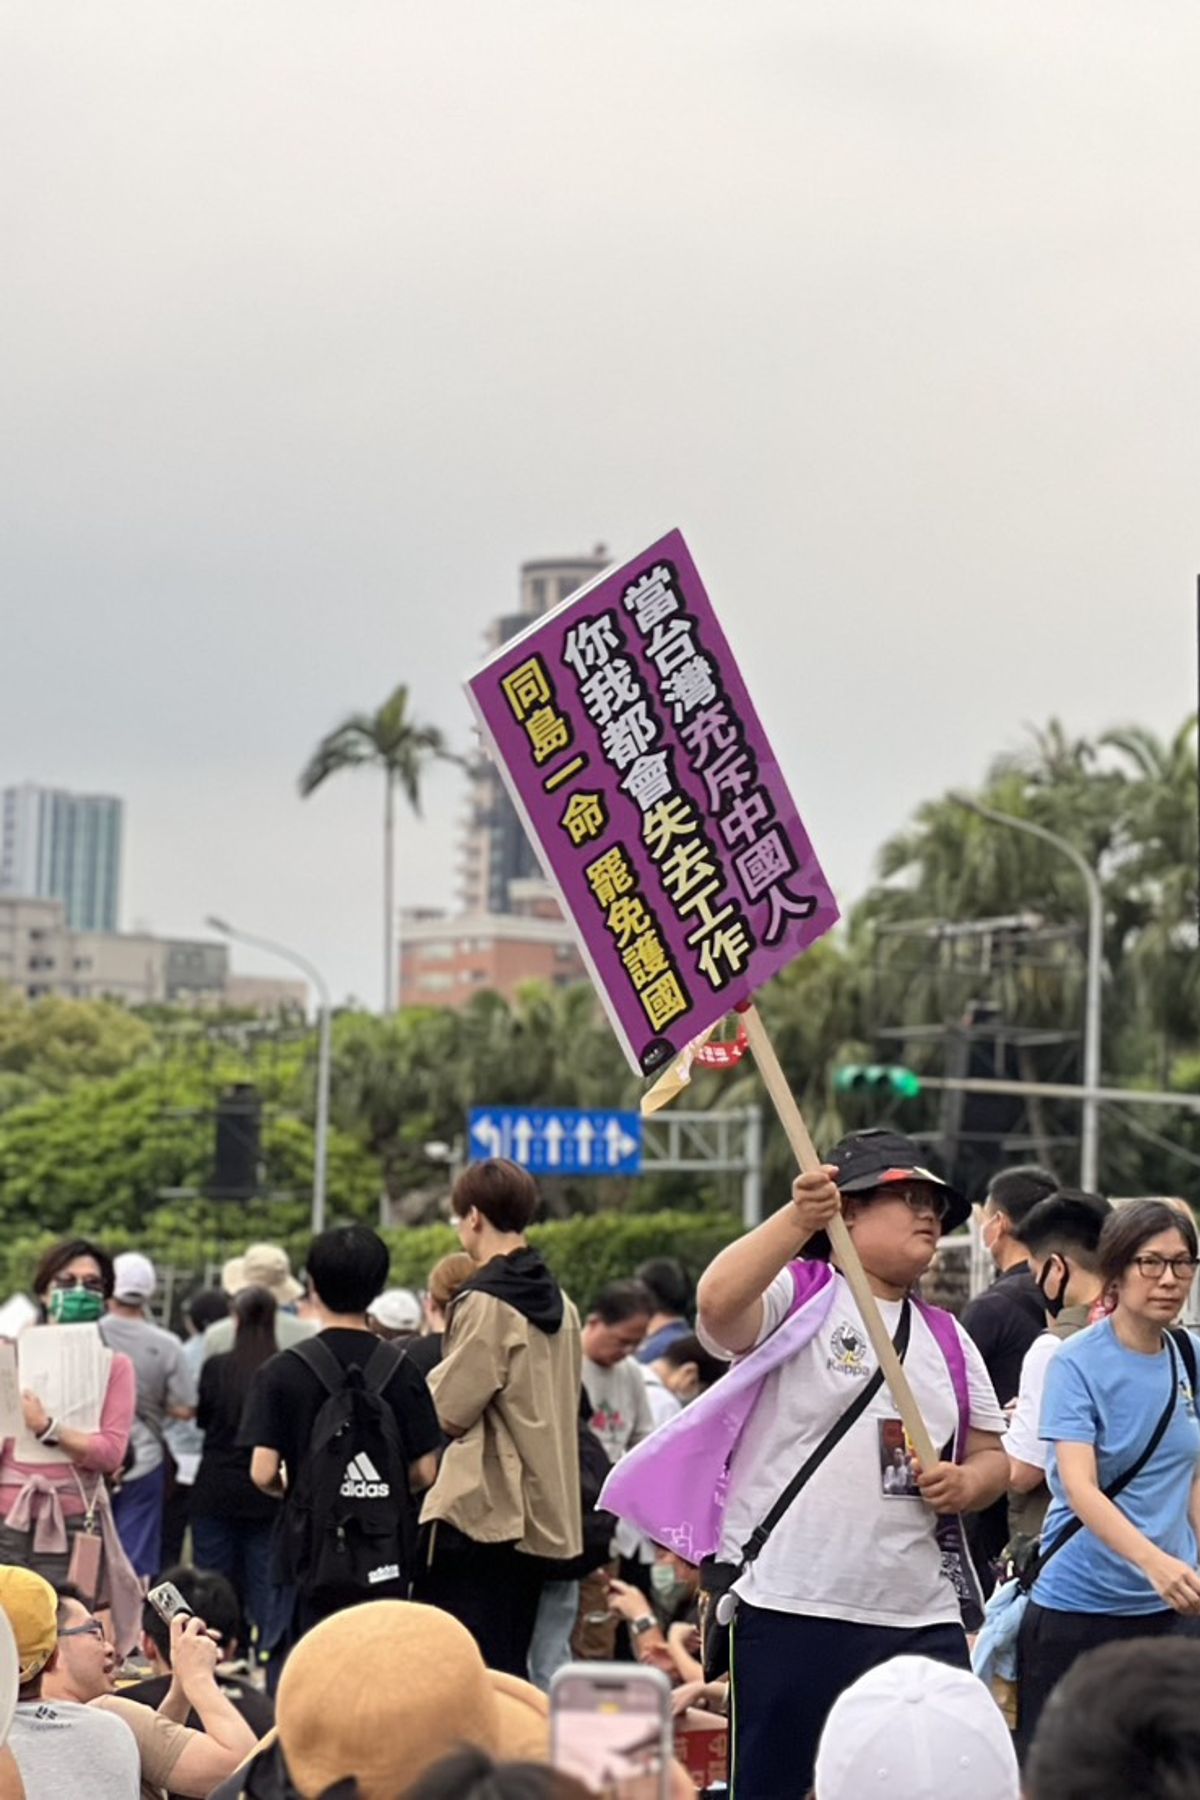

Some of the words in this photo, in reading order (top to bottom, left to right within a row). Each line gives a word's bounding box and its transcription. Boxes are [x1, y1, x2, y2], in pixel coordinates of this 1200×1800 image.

[503, 657, 606, 844] 同島一命
[586, 848, 688, 1031] 罷免護國
[563, 614, 750, 988] 你我都會失去工作
[624, 566, 810, 942] 當台灣充斥中國人
[340, 1479, 390, 1498] adidas
[827, 1359, 870, 1376] Kappa
